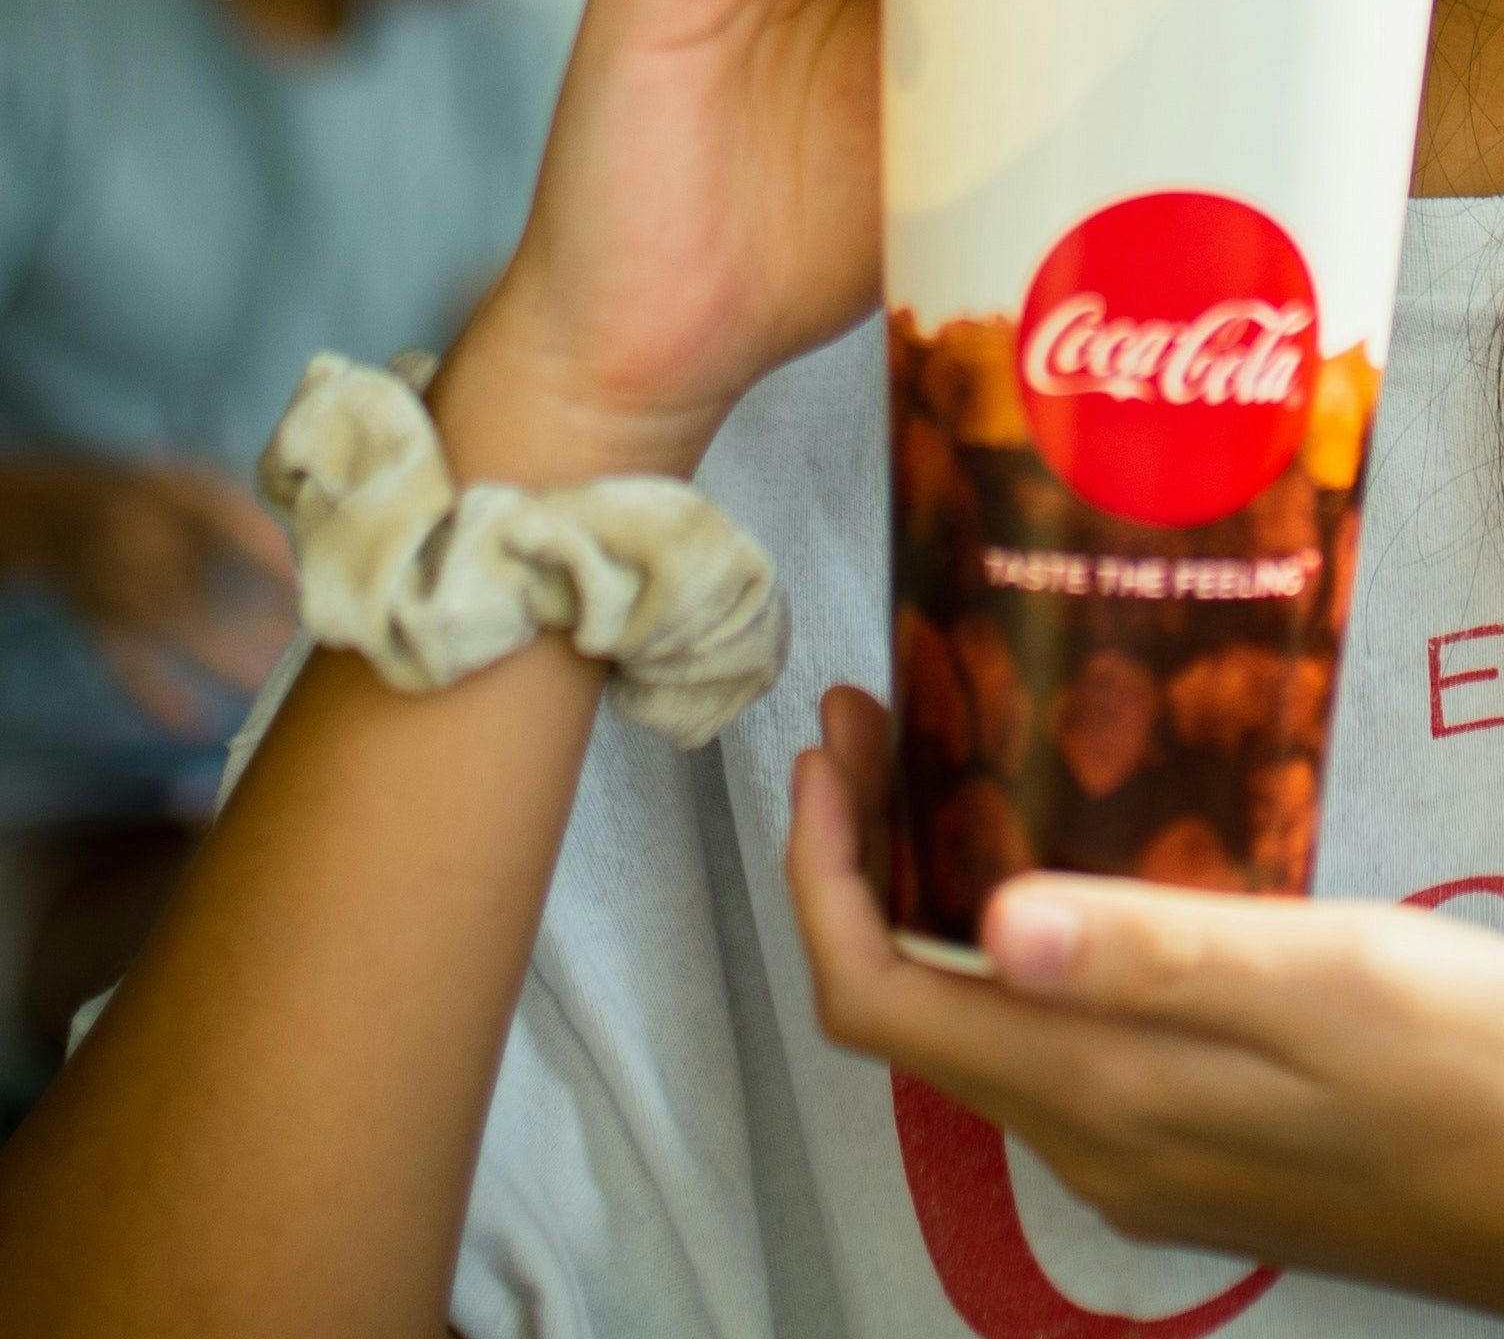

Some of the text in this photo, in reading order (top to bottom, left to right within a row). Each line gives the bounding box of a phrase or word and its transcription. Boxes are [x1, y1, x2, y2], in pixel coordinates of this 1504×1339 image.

[1021, 289, 1314, 406] Coca-Cola
[982, 546, 1090, 595] TASTE
[1095, 552, 1168, 599] THE
